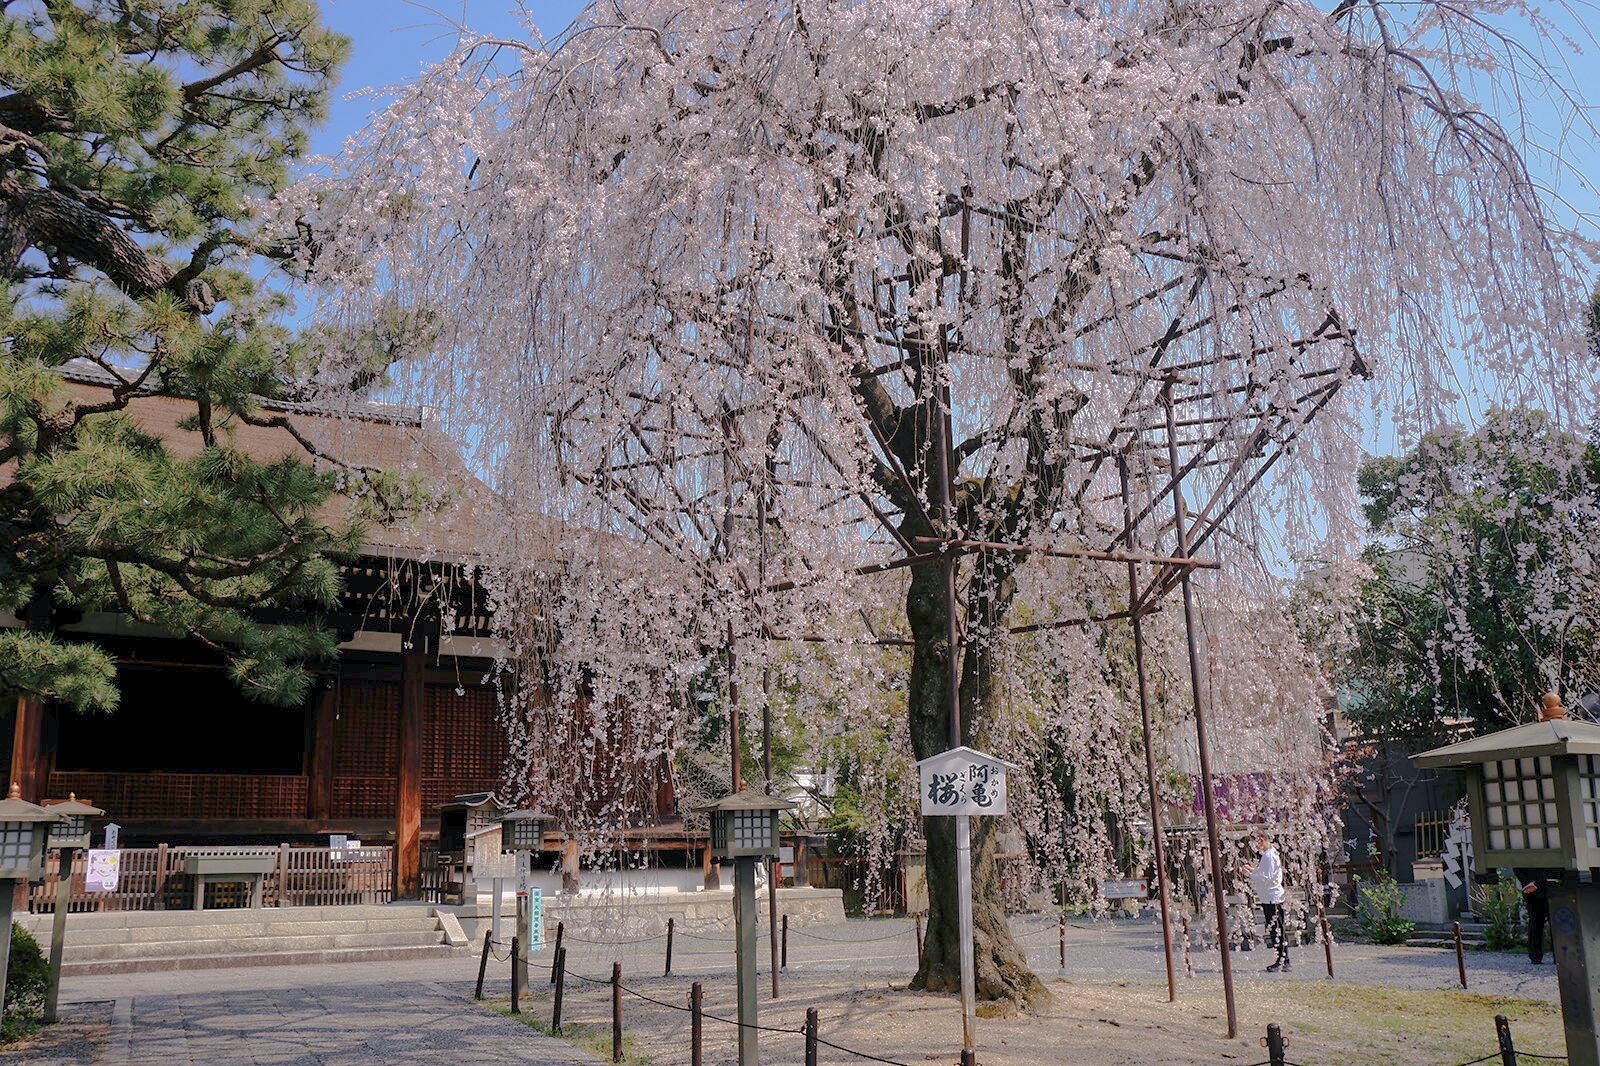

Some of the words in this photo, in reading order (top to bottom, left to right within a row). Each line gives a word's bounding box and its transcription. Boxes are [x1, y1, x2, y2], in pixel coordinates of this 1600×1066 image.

[928, 773, 960, 807] 桜
[960, 771, 968, 804] さくら
[969, 764, 993, 807] 阿亀
[990, 766, 999, 799] おかめ
